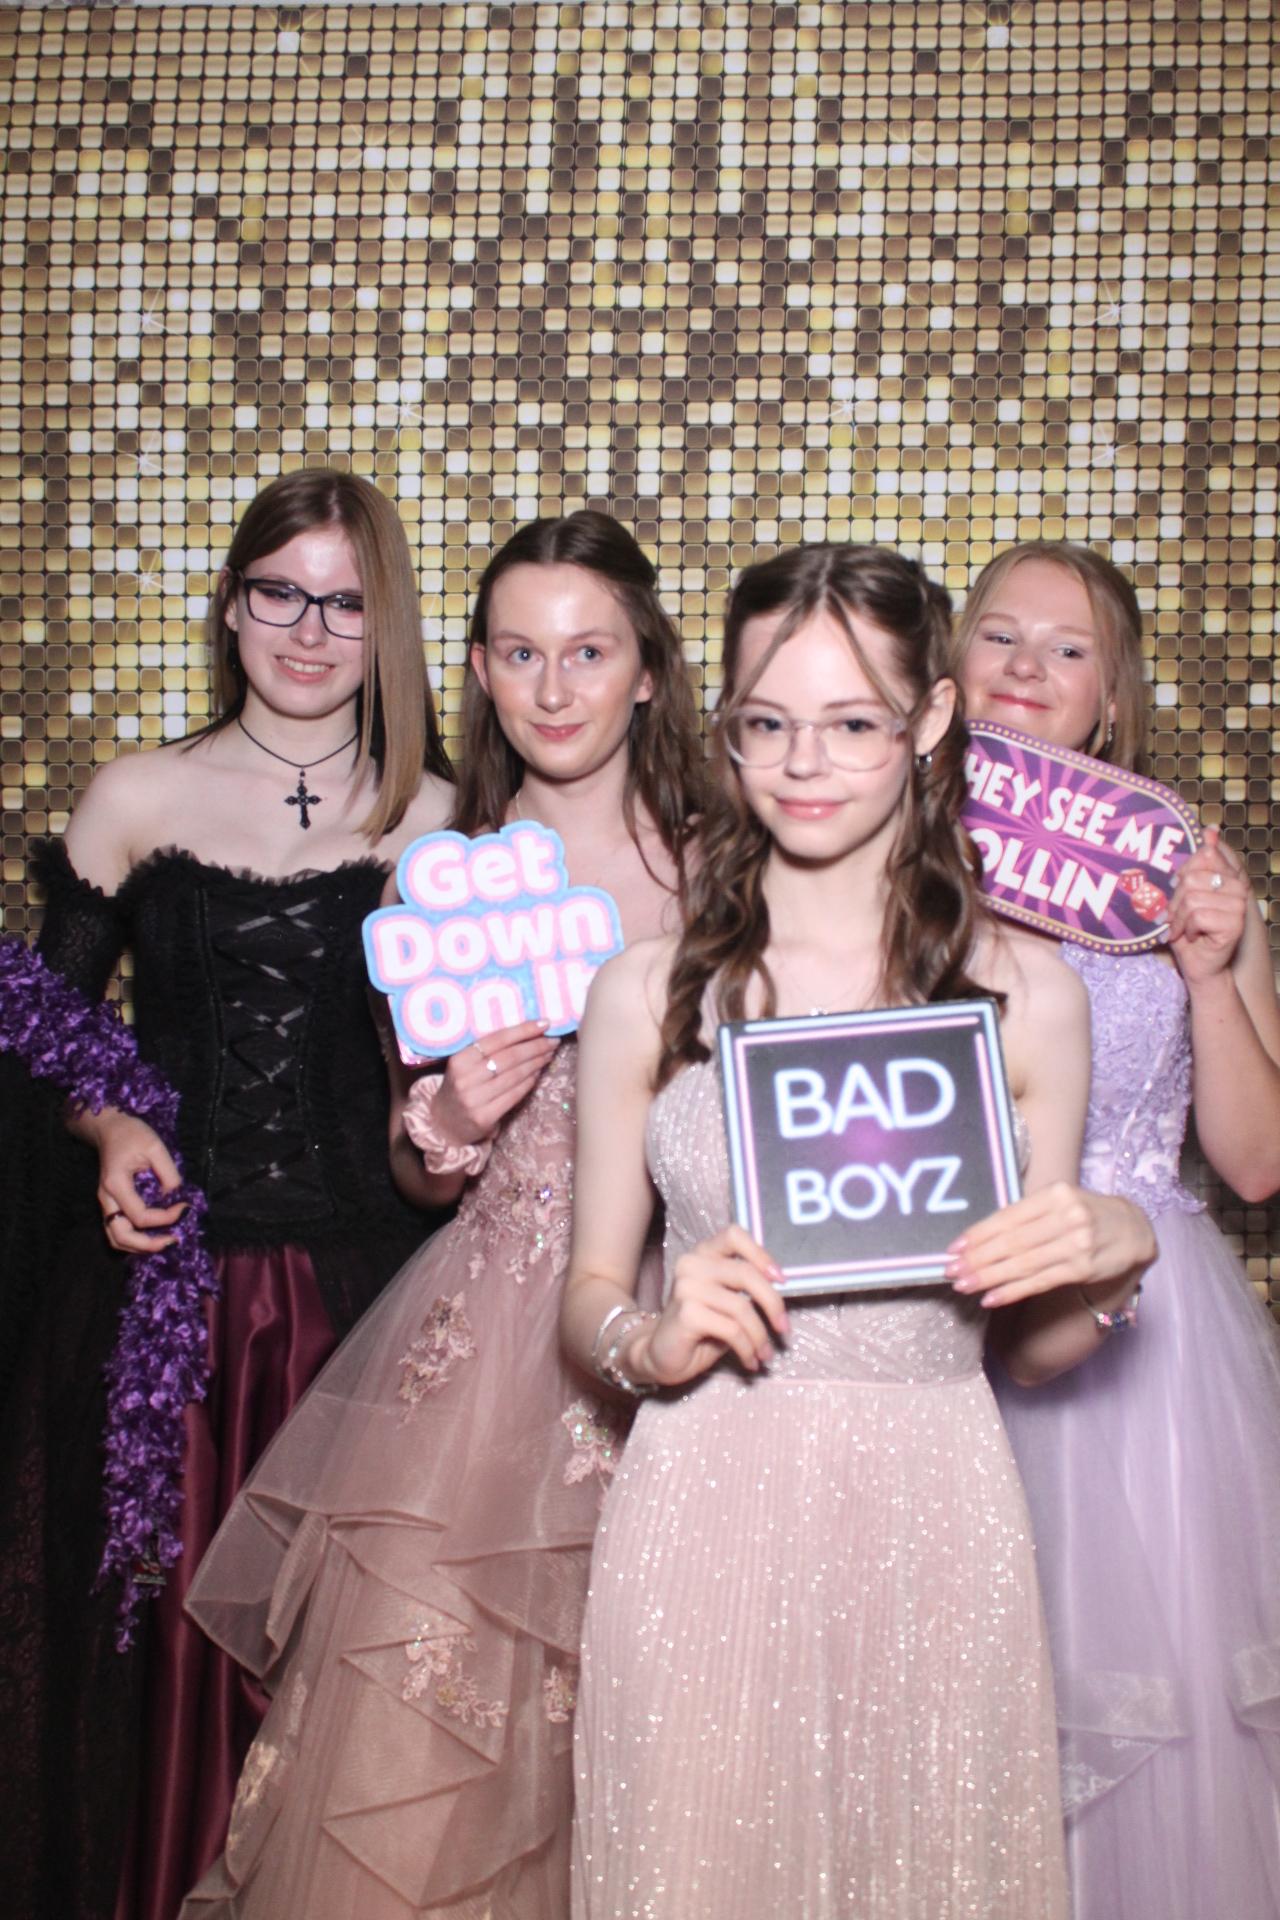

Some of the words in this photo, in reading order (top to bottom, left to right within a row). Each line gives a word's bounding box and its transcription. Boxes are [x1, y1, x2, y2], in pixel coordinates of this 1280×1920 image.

[965, 753, 1042, 817] HEY
[1043, 787, 1116, 846] SEE
[1113, 817, 1184, 873] ME
[411, 832, 552, 904] Get
[969, 827, 1119, 921] OLLIN
[376, 901, 608, 980] Down
[406, 980, 520, 1043] On
[773, 1057, 956, 1139] BAD
[785, 1156, 969, 1225] BOYZ
